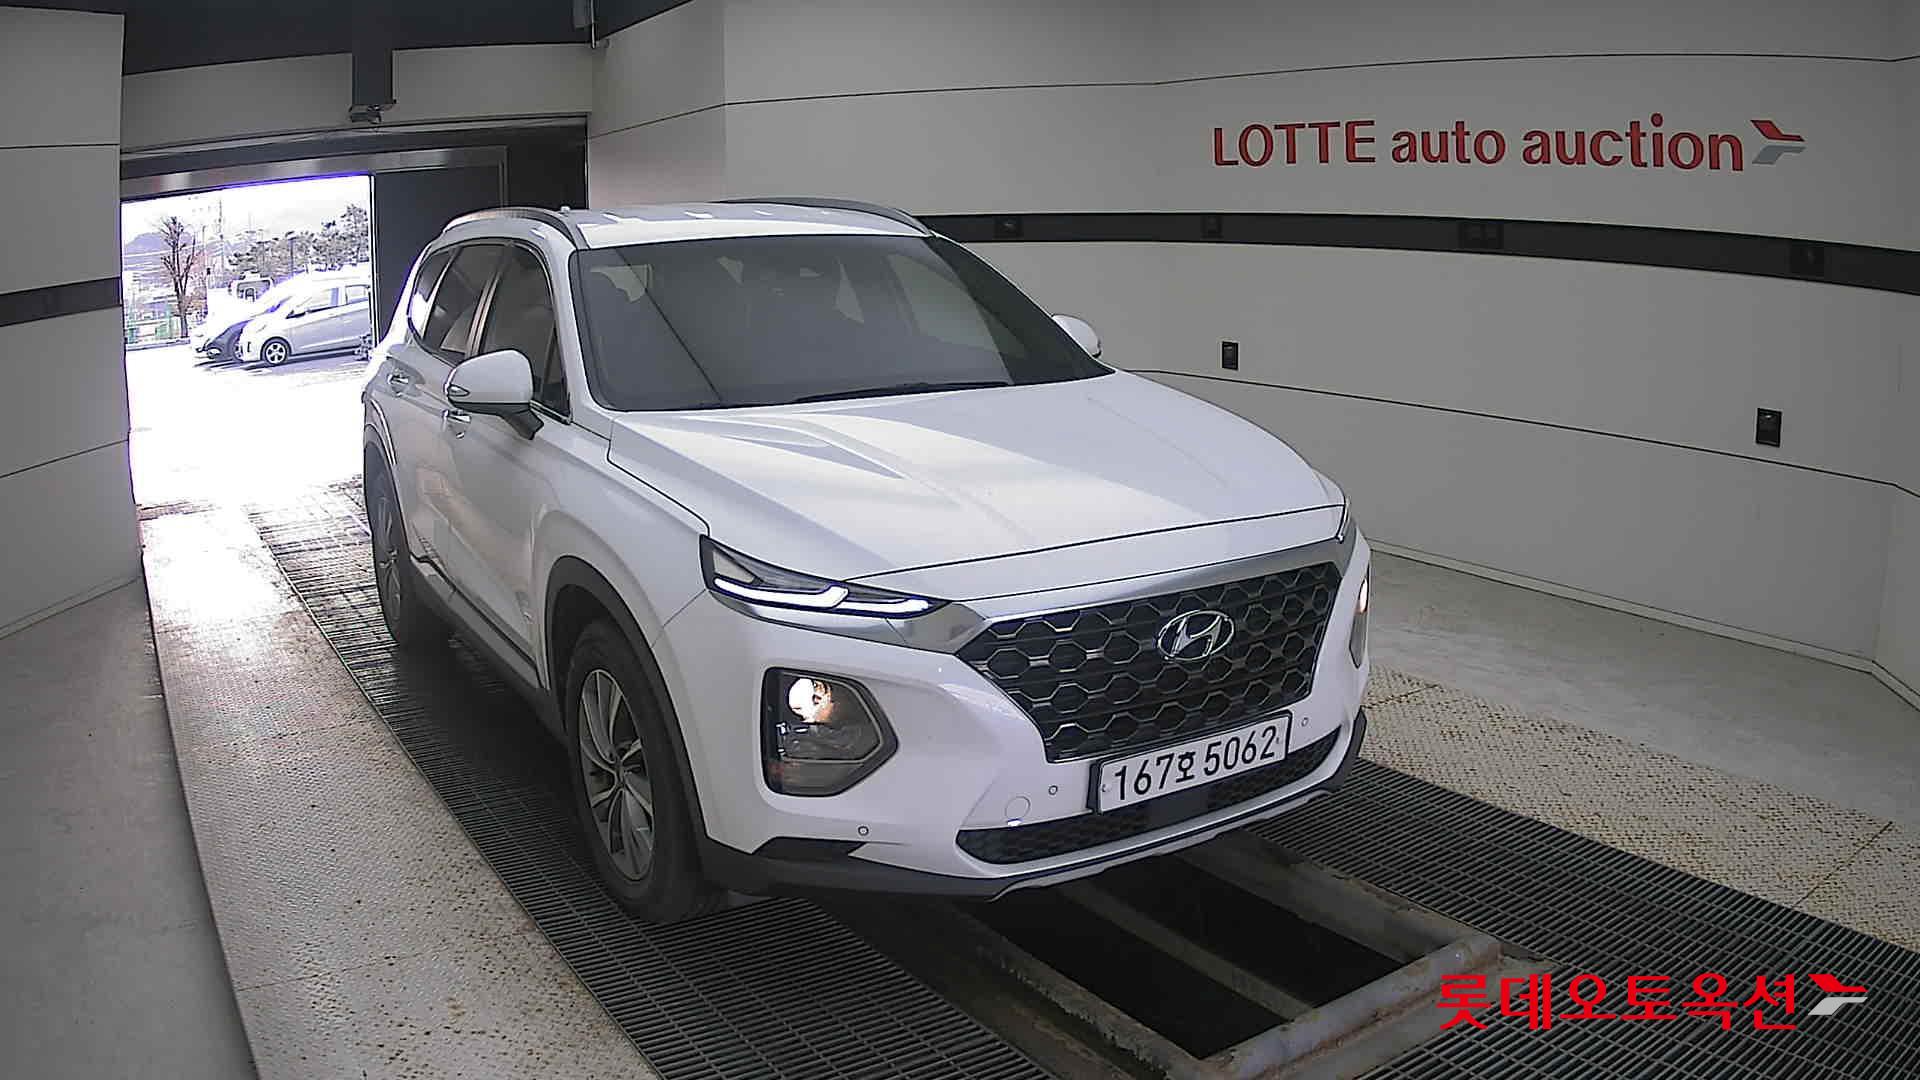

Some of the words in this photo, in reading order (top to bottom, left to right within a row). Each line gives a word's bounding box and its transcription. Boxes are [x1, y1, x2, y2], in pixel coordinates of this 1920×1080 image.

[1214, 119, 1376, 167] LOTTE
[1391, 120, 1507, 166] auto
[1522, 112, 1745, 172] auction
[1114, 751, 1197, 801] 167호
[1203, 725, 1278, 777] 5062
